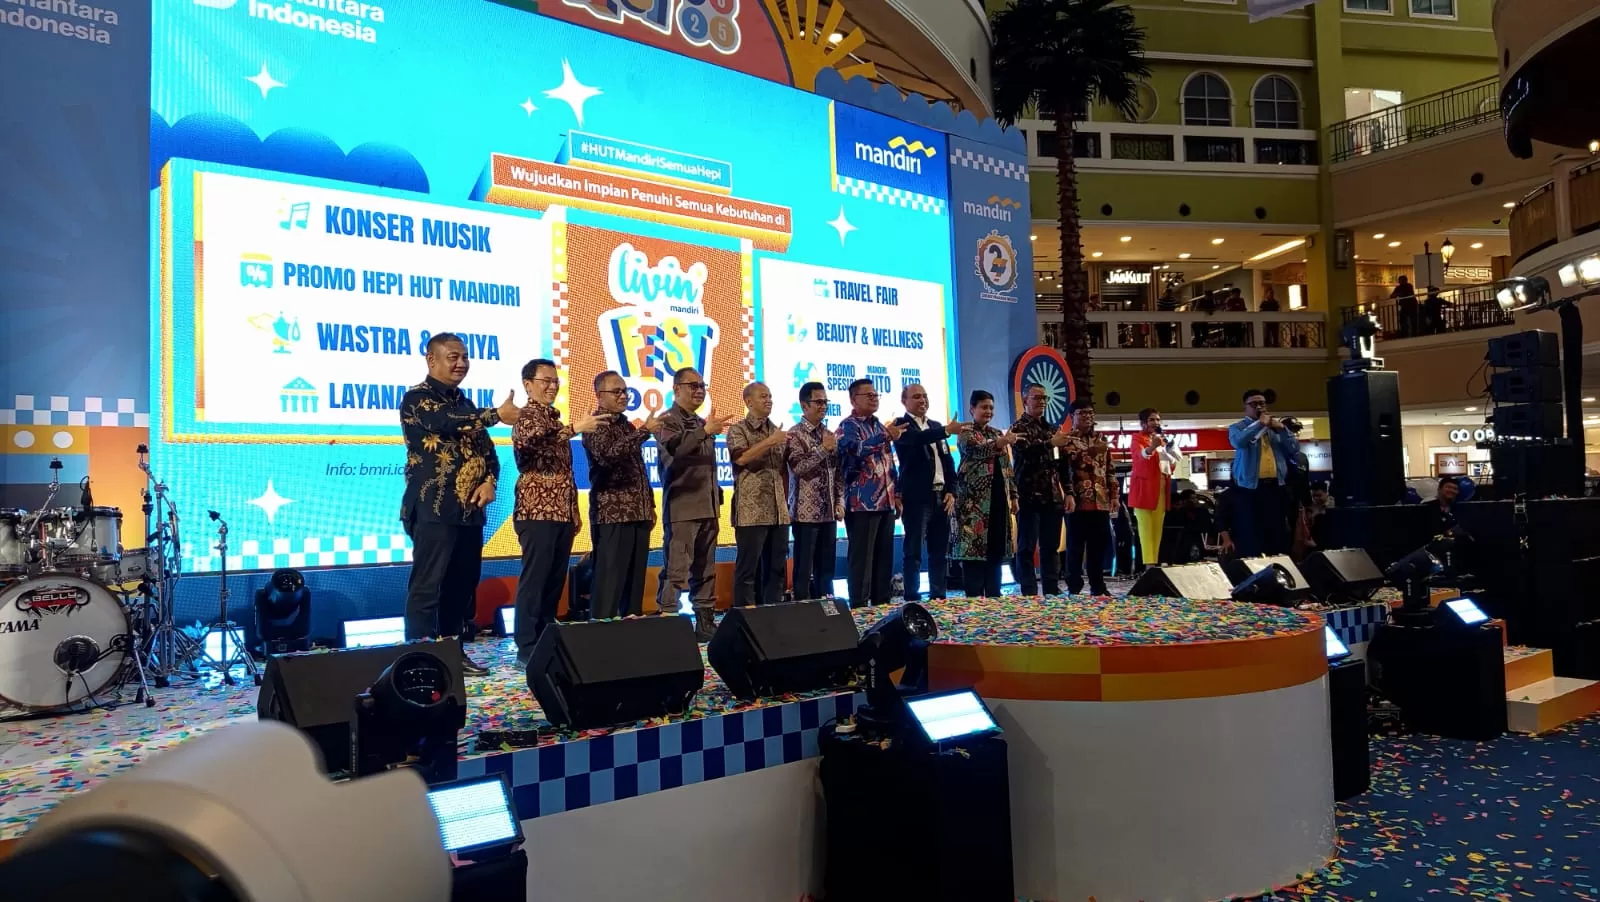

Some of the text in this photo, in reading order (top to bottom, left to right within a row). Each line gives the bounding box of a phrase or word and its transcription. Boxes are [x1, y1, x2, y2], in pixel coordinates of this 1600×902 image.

[4, 0, 118, 25] antara
[249, 0, 377, 43] Indonesia
[296, 0, 384, 22] ntara
[0, 8, 111, 44] donesia
[581, 141, 722, 181] #HUTMandiriSemuaHepi
[855, 141, 922, 175] mandiri
[510, 165, 786, 226] Wujudkan Impian Penuhi Semua Kebutuhan di
[963, 201, 1012, 222] mandiri
[325, 204, 492, 253] KONSER MUSIK
[283, 262, 521, 307] PROMO HEPI HUT MANDIRI
[618, 250, 698, 303] livin
[833, 279, 899, 306] TRAVEL FAIR
[670, 304, 700, 315] mandiri
[317, 322, 412, 355] WASTRA
[454, 332, 500, 360] IYA
[610, 314, 714, 382] FEST
[816, 321, 924, 350] BEAUTY & WELLNESS
[827, 363, 855, 378] PROMO
[828, 377, 856, 391] SPESI
[865, 375, 891, 393] UTO
[328, 382, 413, 410] LAYANA
[326, 462, 357, 476] Info:
[32, 591, 77, 601] BELLY
